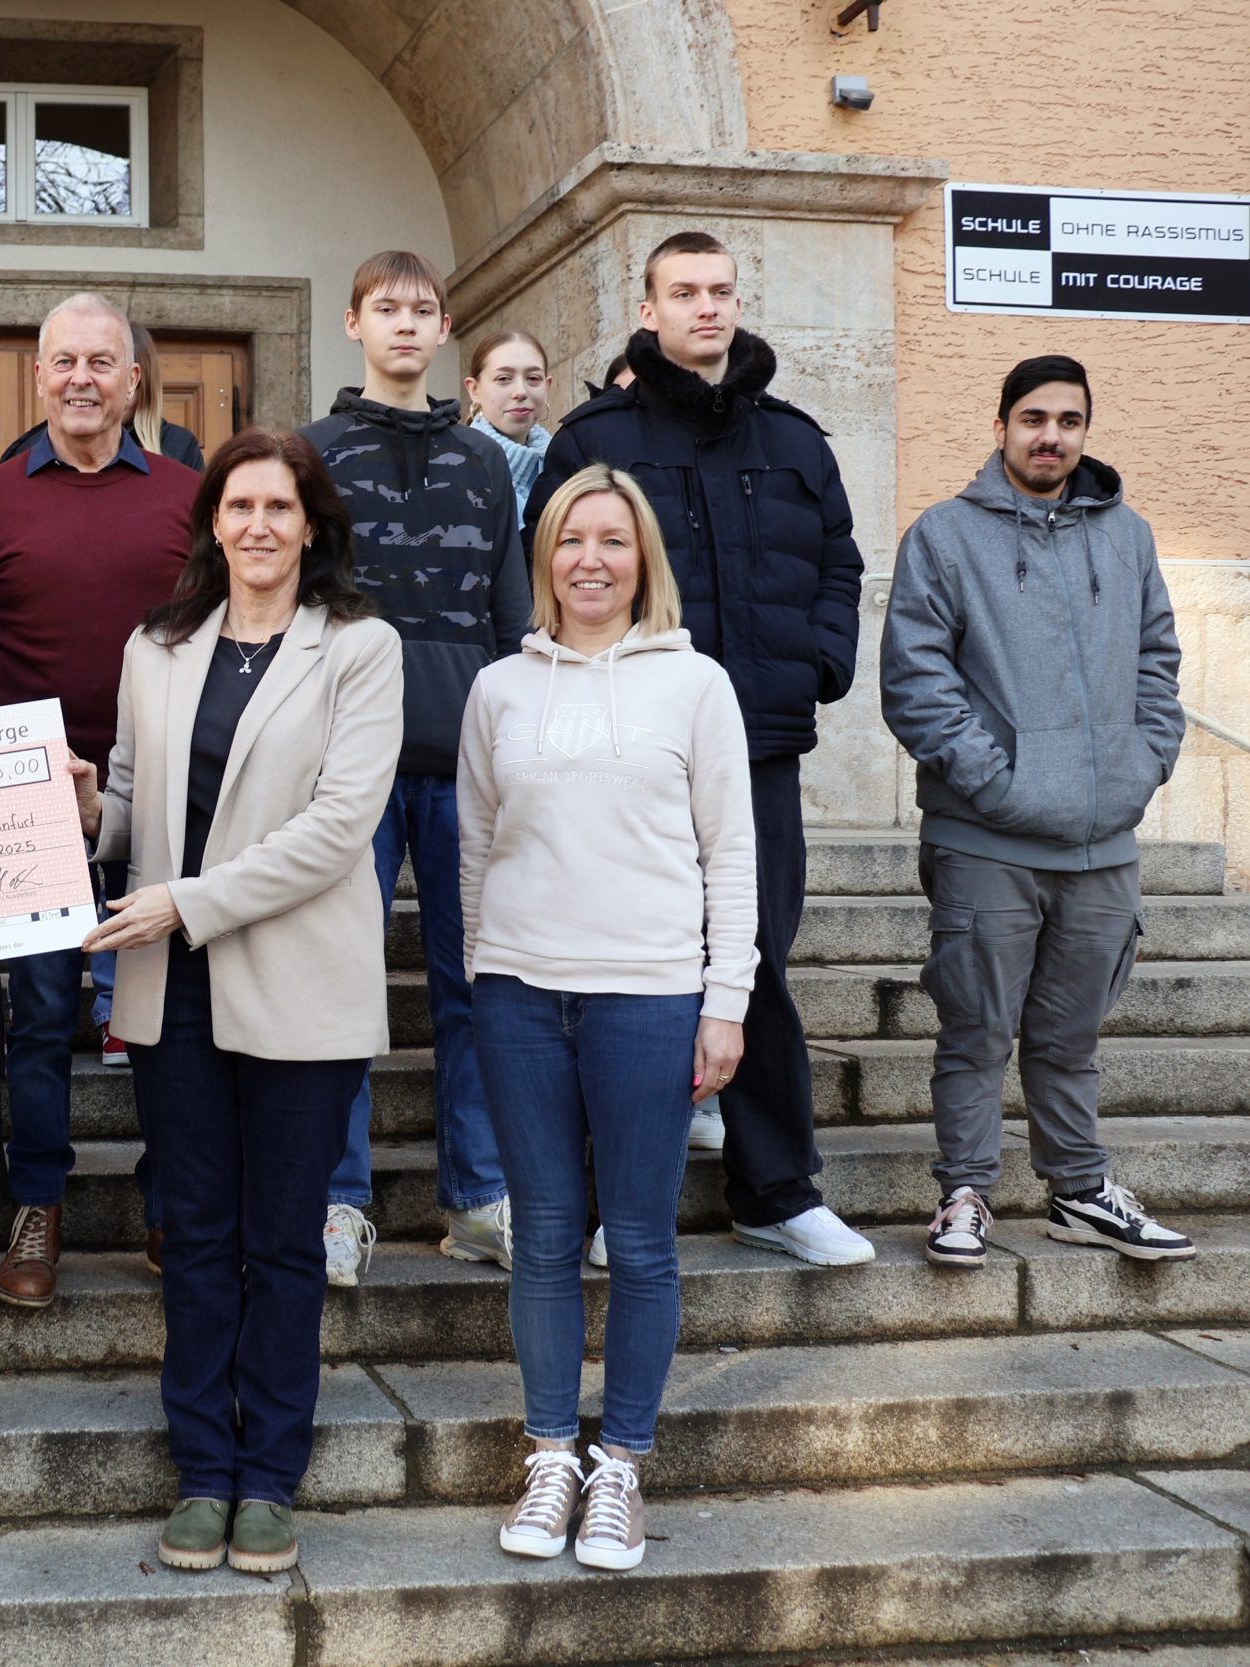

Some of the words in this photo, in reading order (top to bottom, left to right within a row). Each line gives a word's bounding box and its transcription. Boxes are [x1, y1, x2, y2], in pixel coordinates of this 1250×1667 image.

[961, 216, 1041, 234] SCHULE
[1061, 222, 1117, 237] OHNE
[1126, 225, 1245, 242] RASSISMUS
[962, 267, 1041, 284] SCHULE
[1061, 271, 1098, 288] MIT
[1106, 273, 1204, 292] COURAGE
